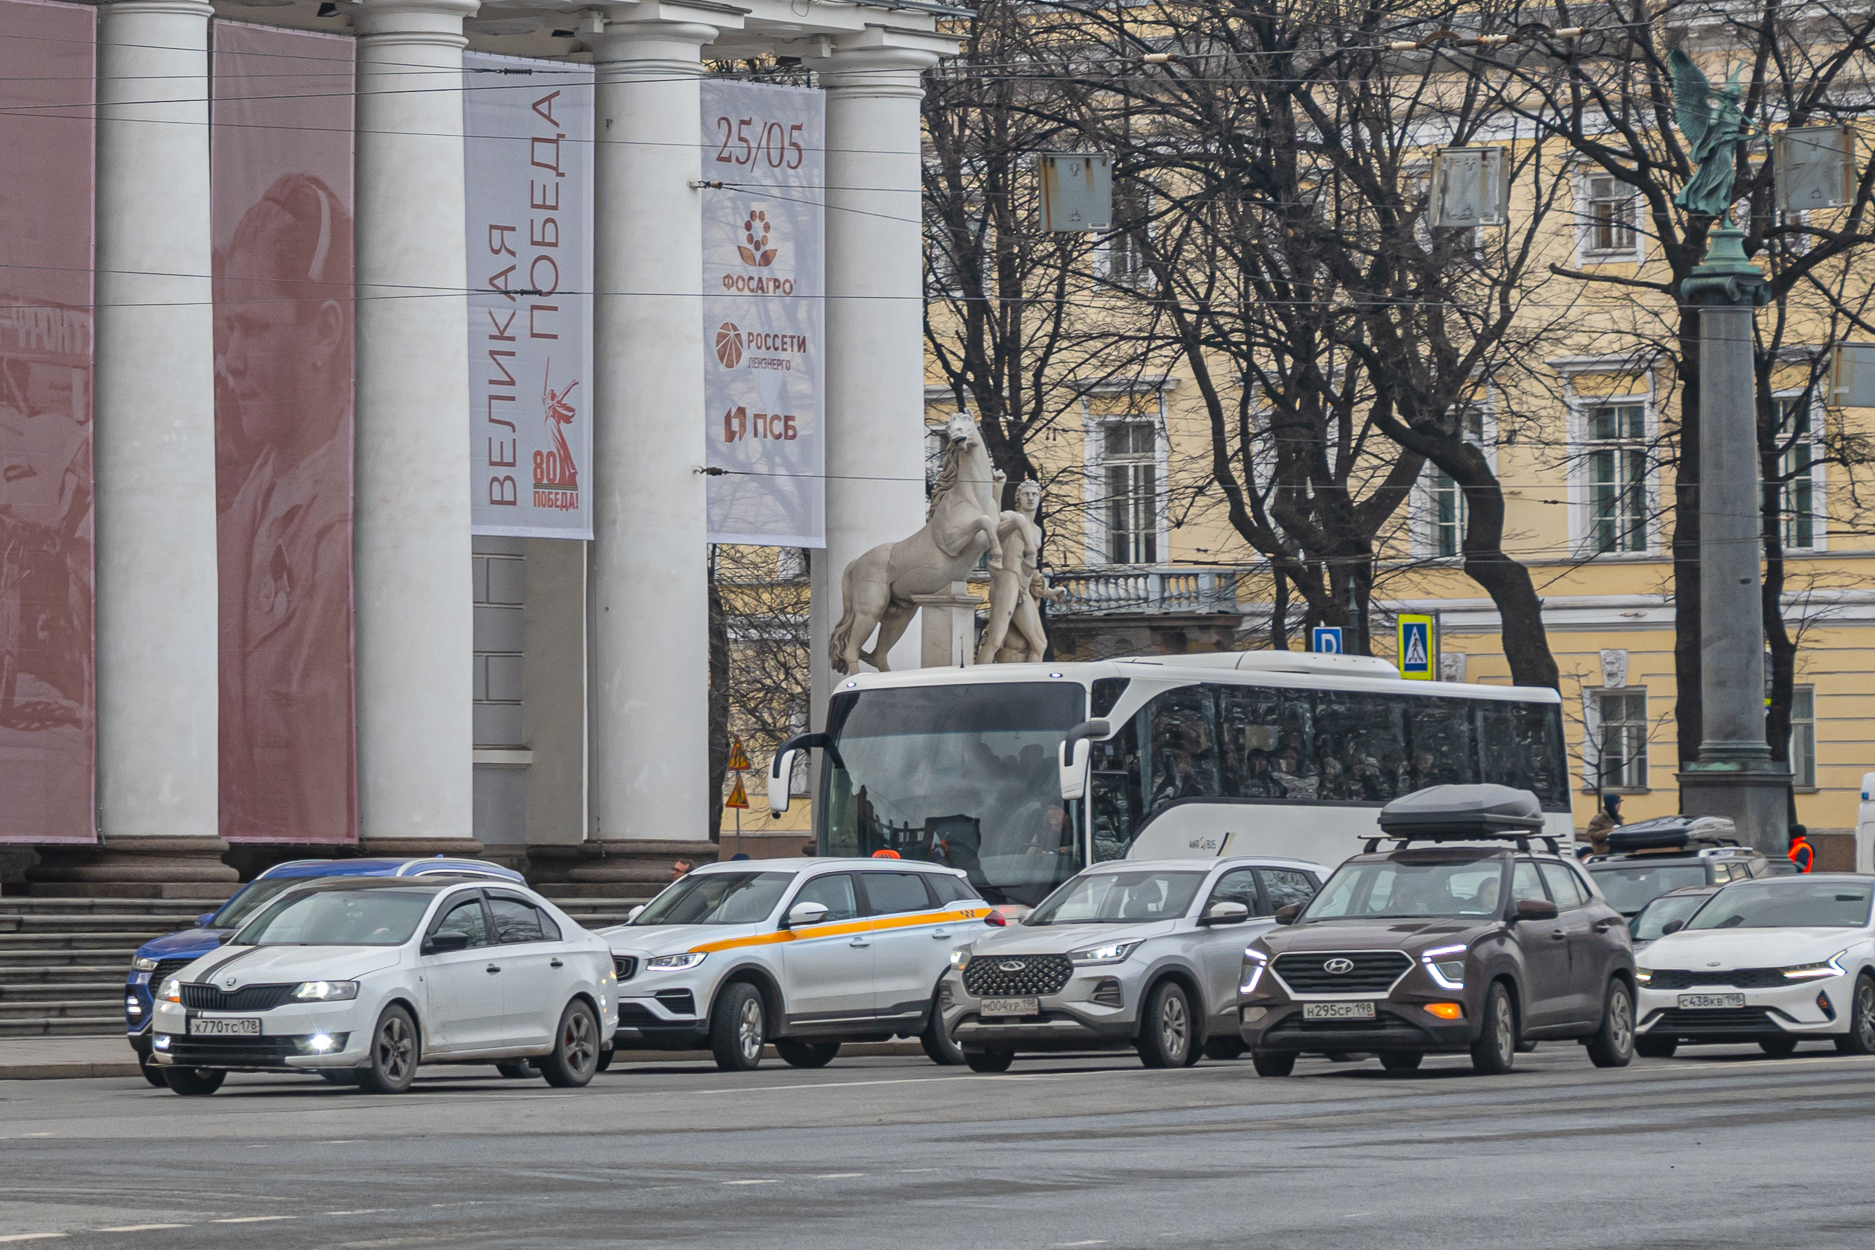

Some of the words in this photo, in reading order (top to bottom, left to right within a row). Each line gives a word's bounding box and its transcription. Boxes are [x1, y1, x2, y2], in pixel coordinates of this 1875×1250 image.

[716, 116, 804, 173] 25/05
[529, 89, 566, 340] ПОБЕДА
[722, 273, 794, 296] ФОСАГРО
[747, 331, 807, 354] РОССЕТИ
[488, 224, 518, 507] ВЕЛИКАЯ
[748, 357, 791, 371] ЛЕНЭНЕРГО
[753, 414, 797, 441] ПСБ
[532, 449, 557, 484] 80
[533, 490, 579, 512] ПОБЕДА!
[1354, 1003, 1372, 1013] 198
[239, 1020, 257, 1030] 178
